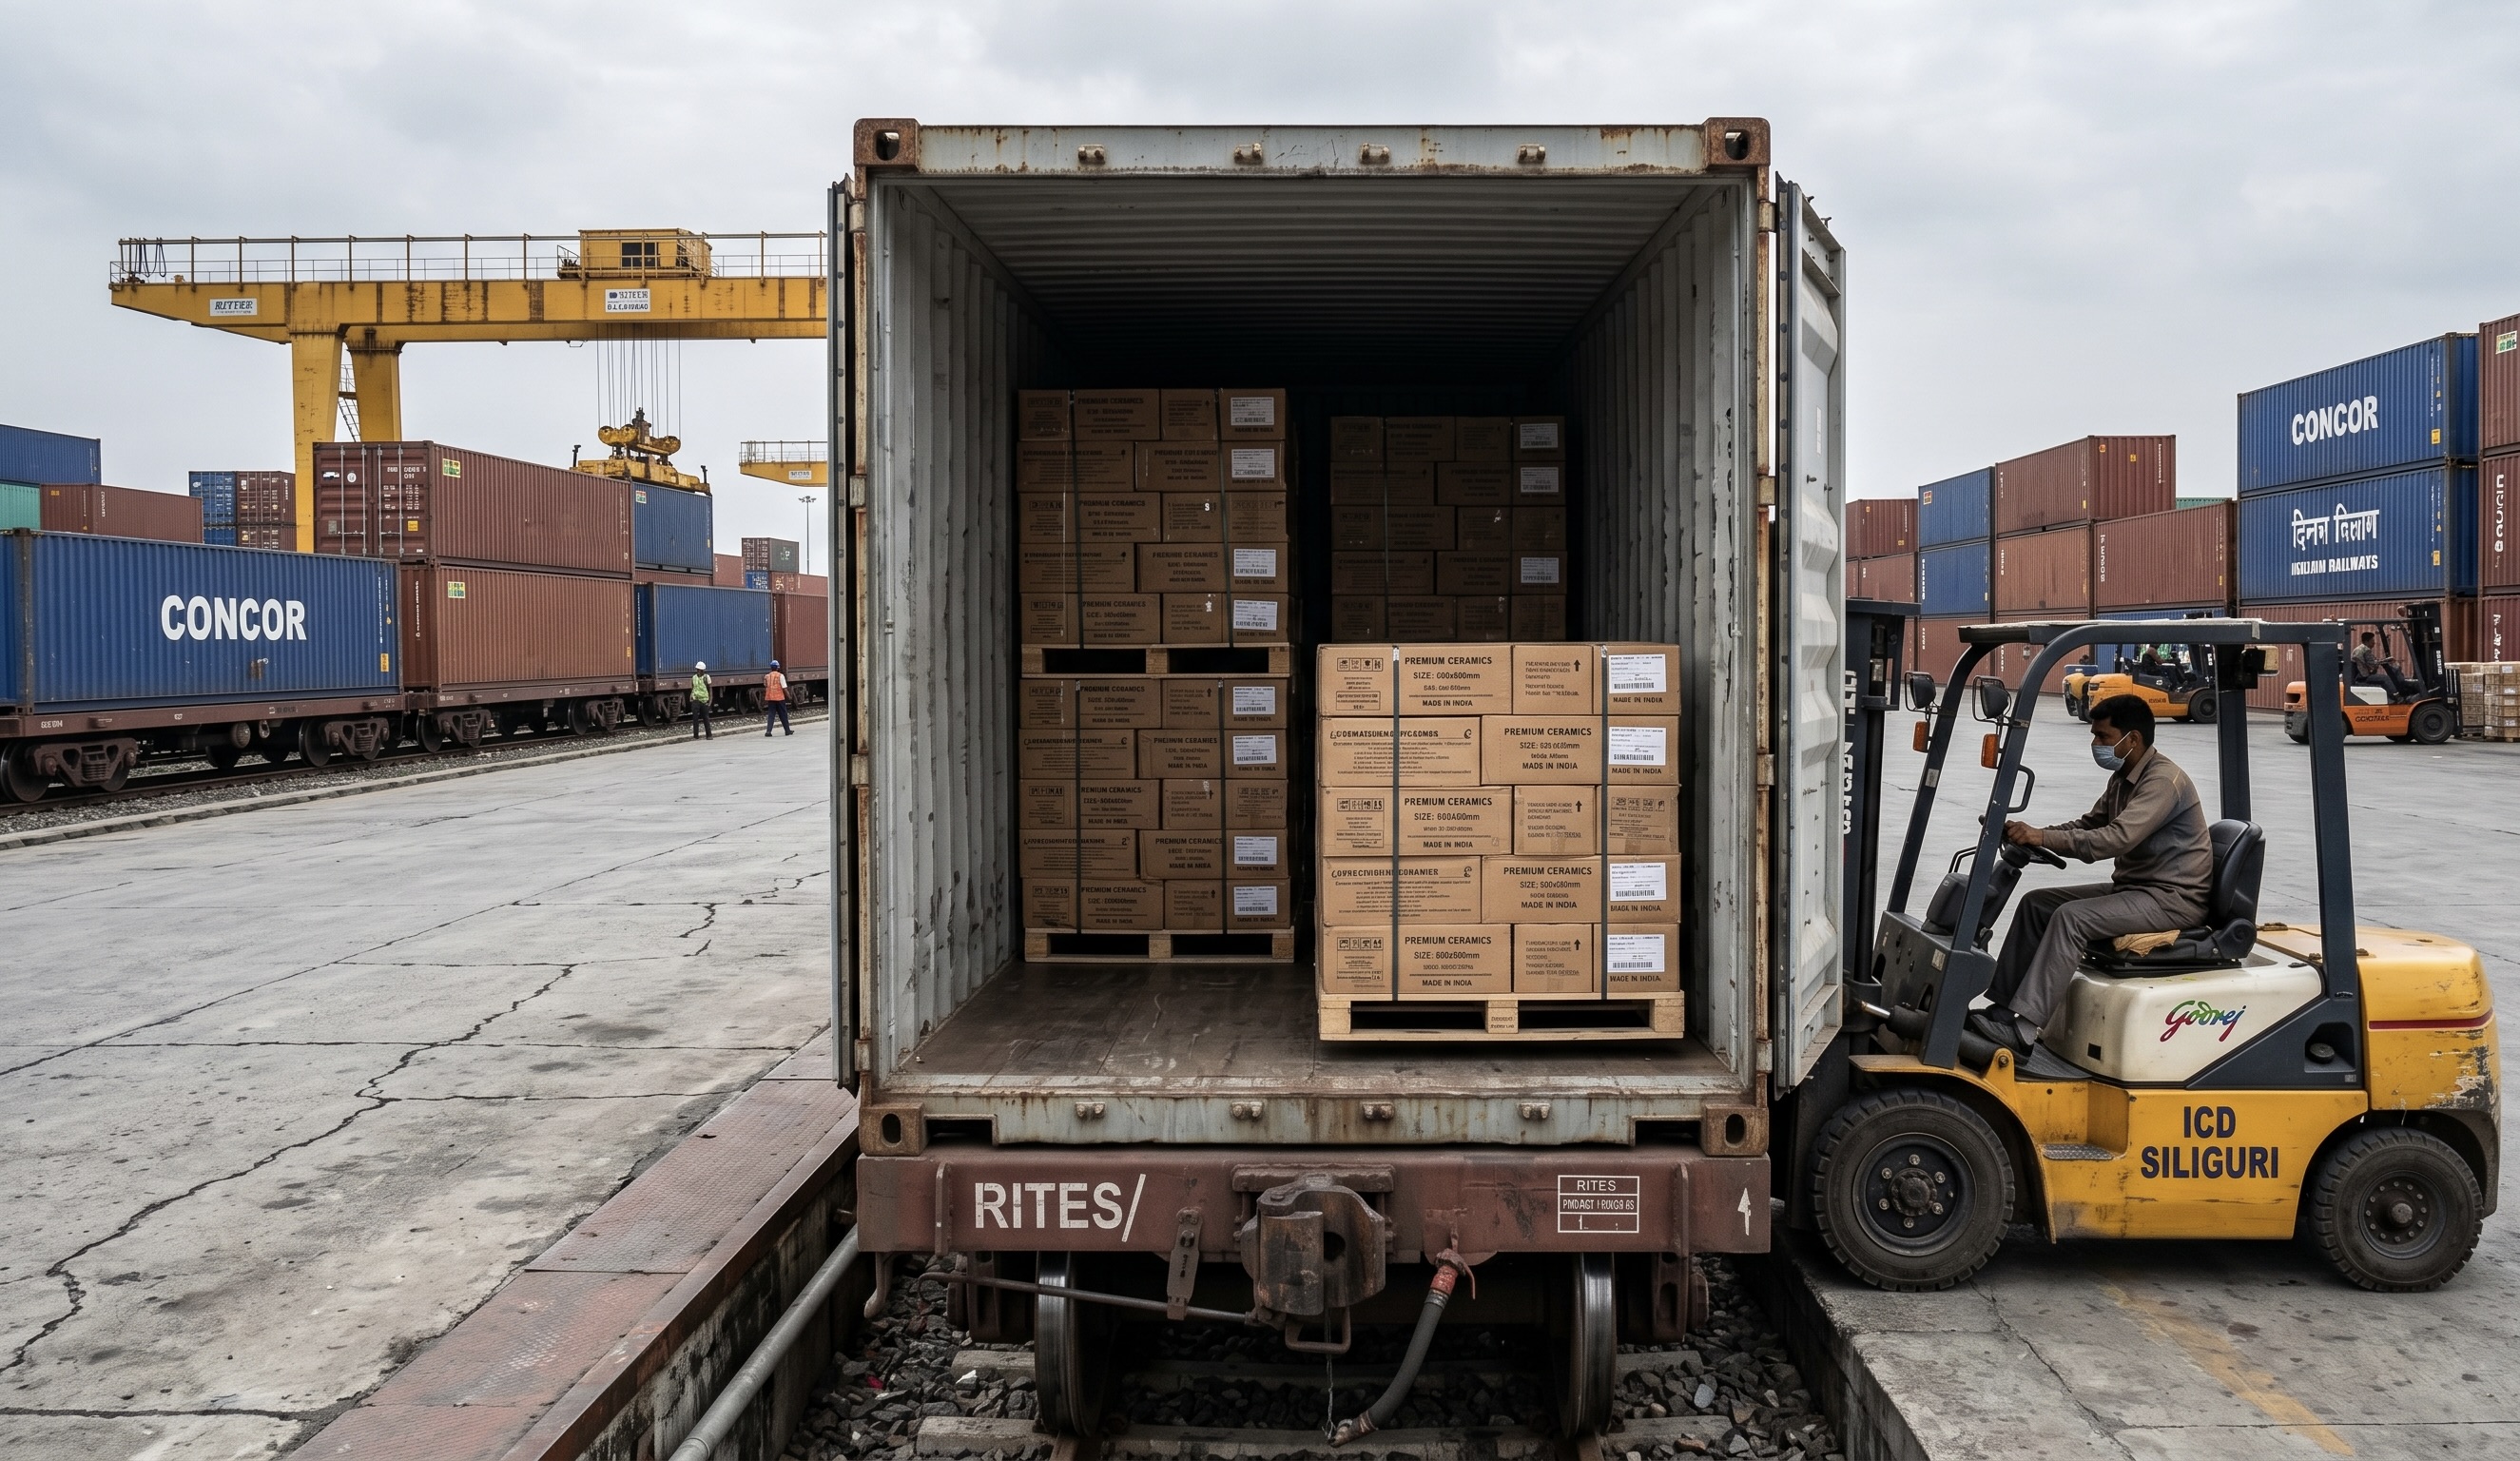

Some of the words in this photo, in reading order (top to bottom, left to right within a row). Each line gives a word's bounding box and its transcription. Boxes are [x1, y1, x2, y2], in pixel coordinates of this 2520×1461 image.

[2292, 396, 2378, 445] CONCOR
[161, 594, 307, 641] CONCOR
[1405, 936, 1444, 945] PREMIUM
[1448, 936, 1491, 945] CERAMICS
[2160, 1000, 2247, 1042] Godrej
[2183, 1105, 2237, 1139] ICD
[2141, 1145, 2278, 1179] SILIGURI
[1577, 1179, 1617, 1191] RITES
